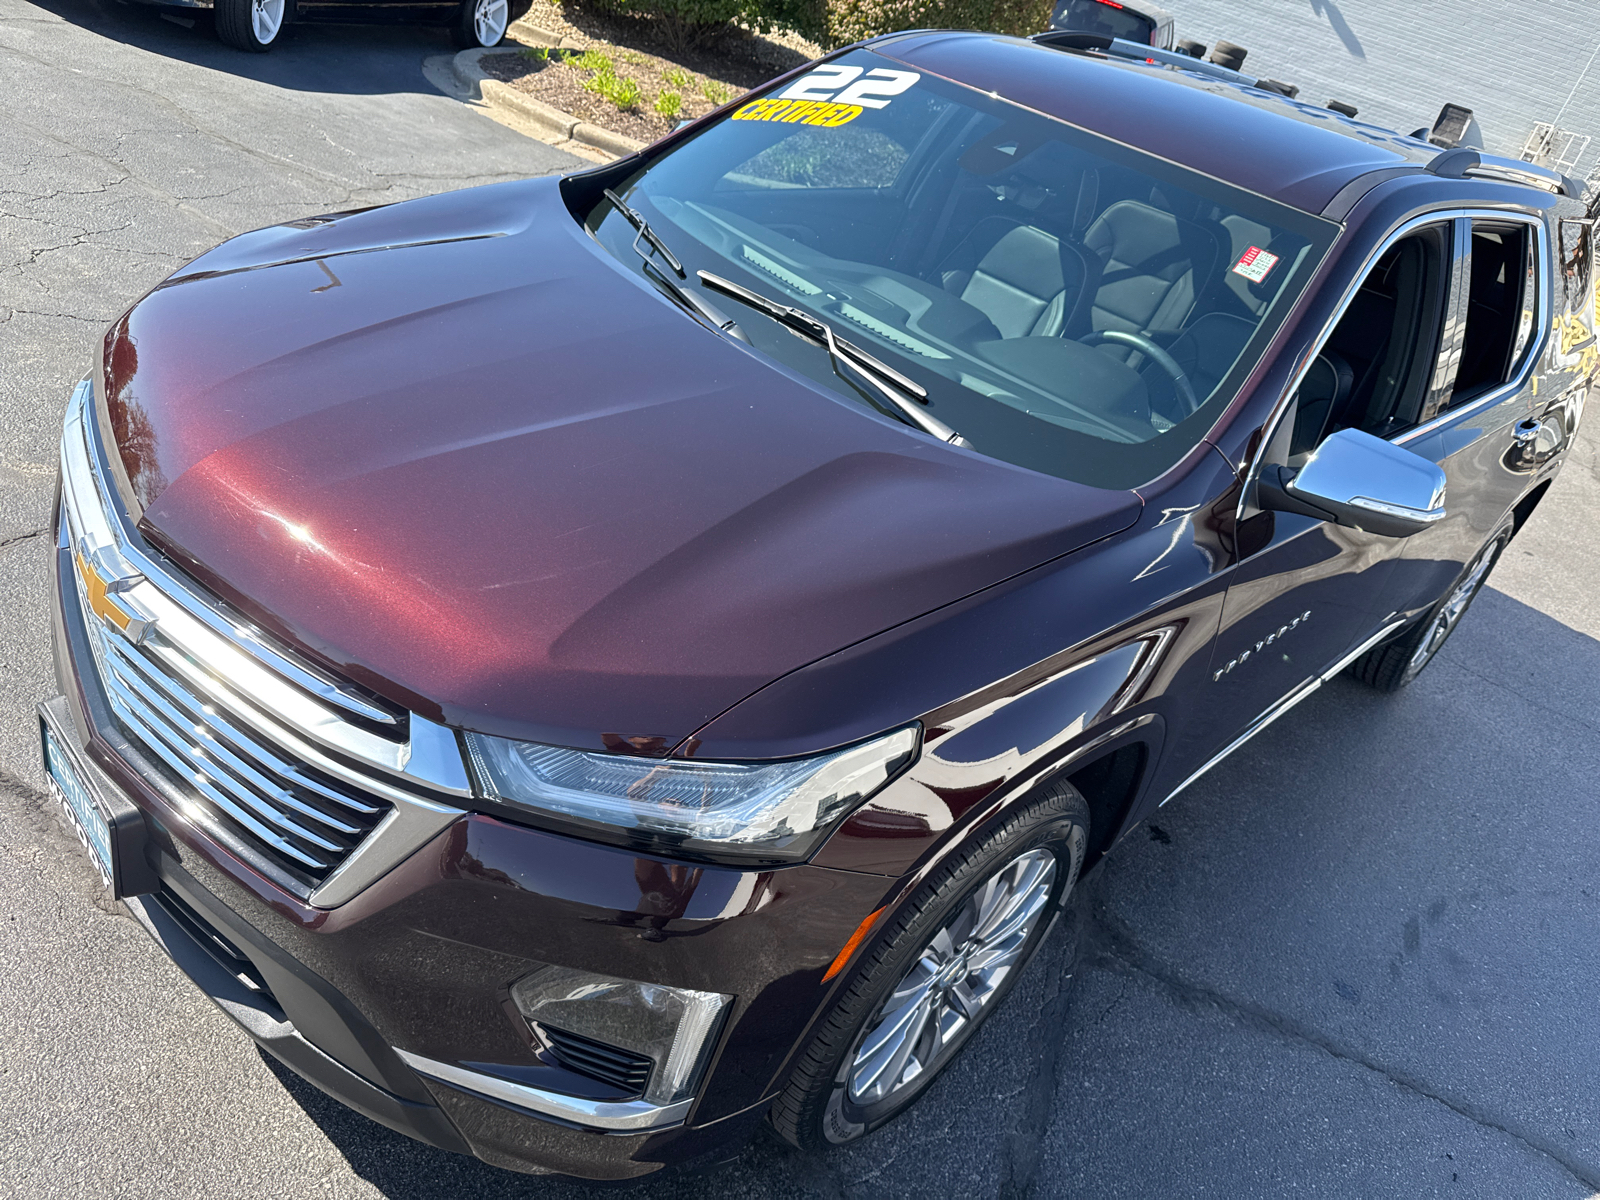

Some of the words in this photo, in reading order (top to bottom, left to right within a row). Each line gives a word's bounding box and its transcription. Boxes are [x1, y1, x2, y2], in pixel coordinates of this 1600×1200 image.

[778, 63, 921, 110] 22
[731, 98, 864, 128] CERTIFIED
[1212, 610, 1312, 682] TRAVERSE
